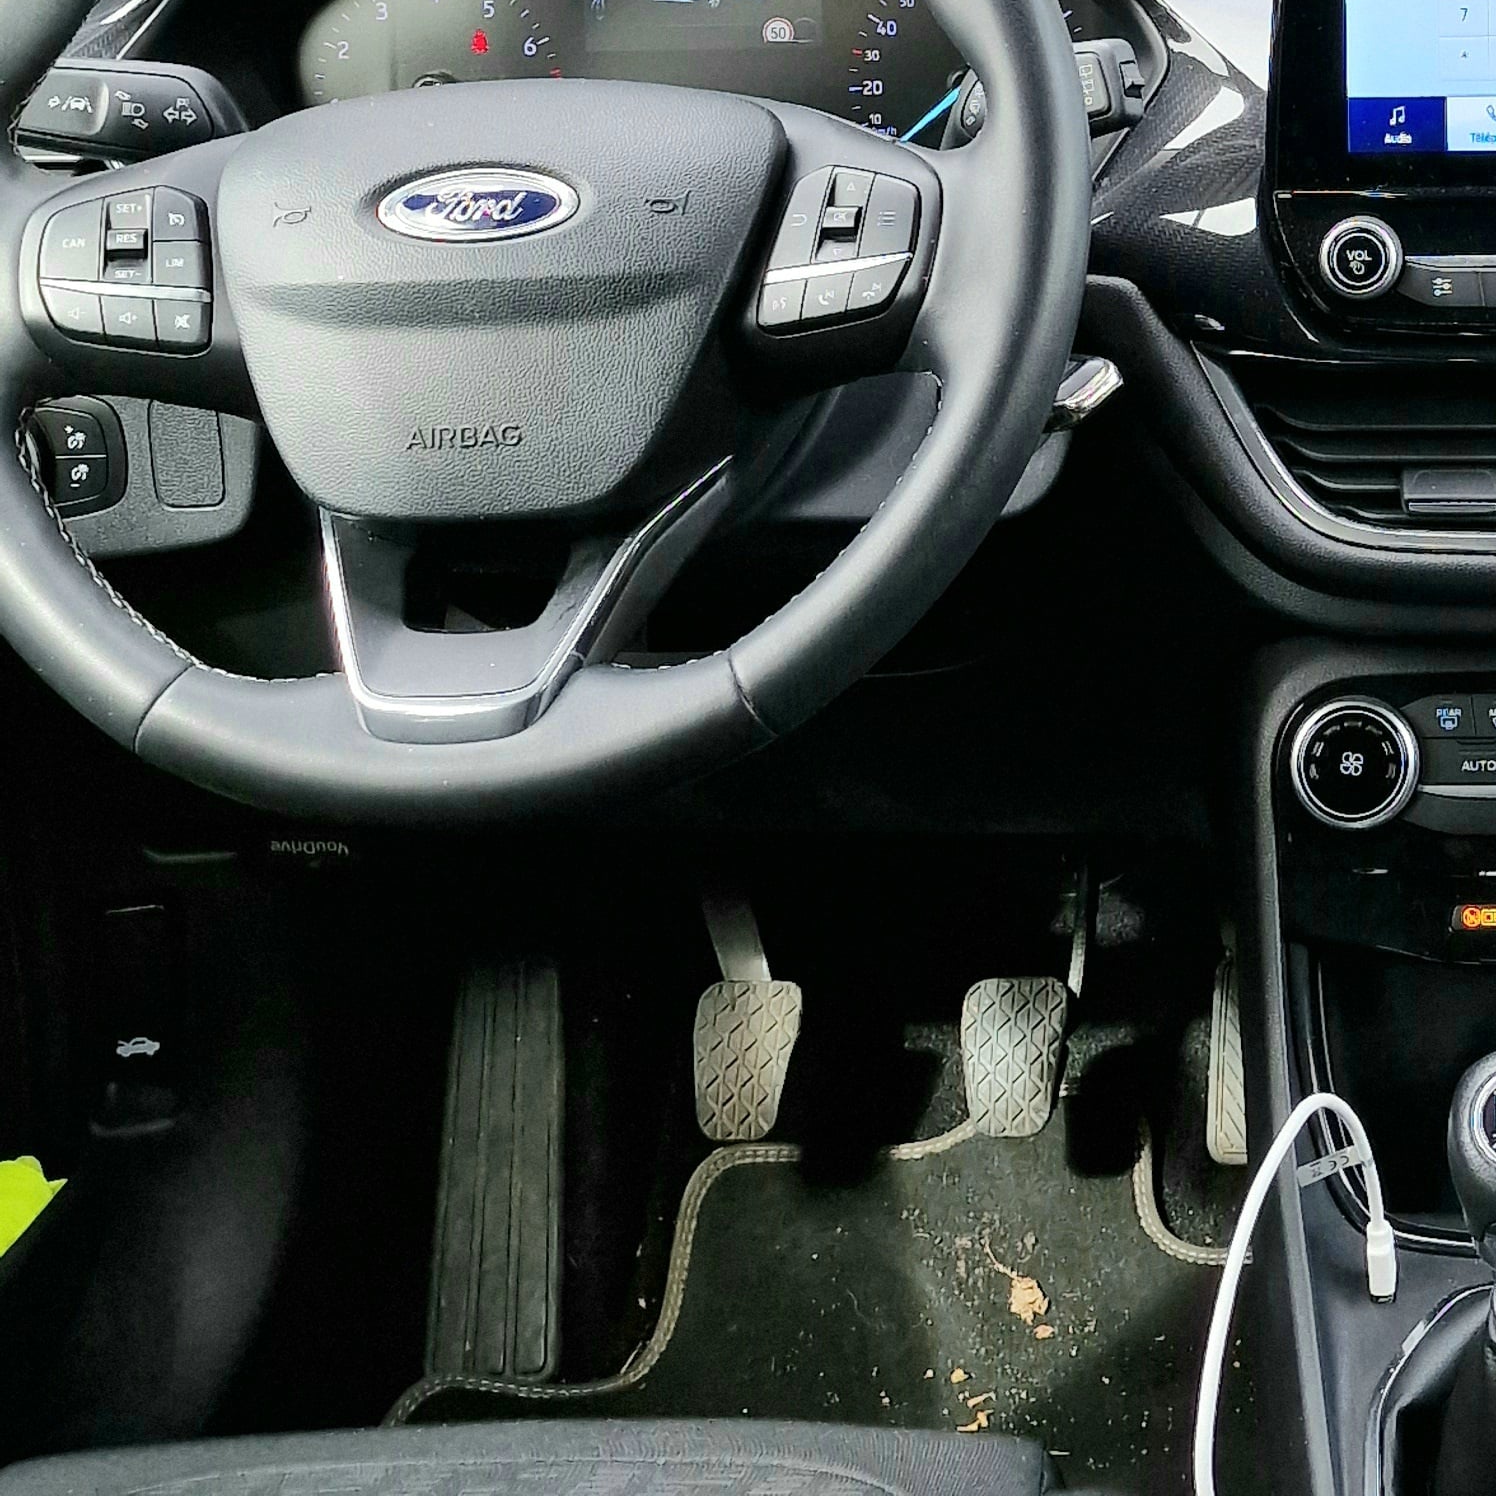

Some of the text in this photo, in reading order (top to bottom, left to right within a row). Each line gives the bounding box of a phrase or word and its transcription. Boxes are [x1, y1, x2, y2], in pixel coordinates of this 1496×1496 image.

[375, 2, 388, 21] 3
[482, 0, 495, 18] 5
[1460, 7, 1468, 21] 7
[770, 27, 787, 40] 50
[337, 41, 349, 59] 2
[523, 36, 537, 56] 6
[864, 49, 880, 61] 30
[862, 80, 883, 95] 20
[869, 113, 882, 125] 10
[425, 187, 528, 222] Ford
[62, 238, 86, 249] CAN
[115, 233, 138, 244] RES
[1346, 249, 1373, 261] VOL
[407, 424, 523, 449] AIRBAG
[270, 840, 350, 855] YouDrive
